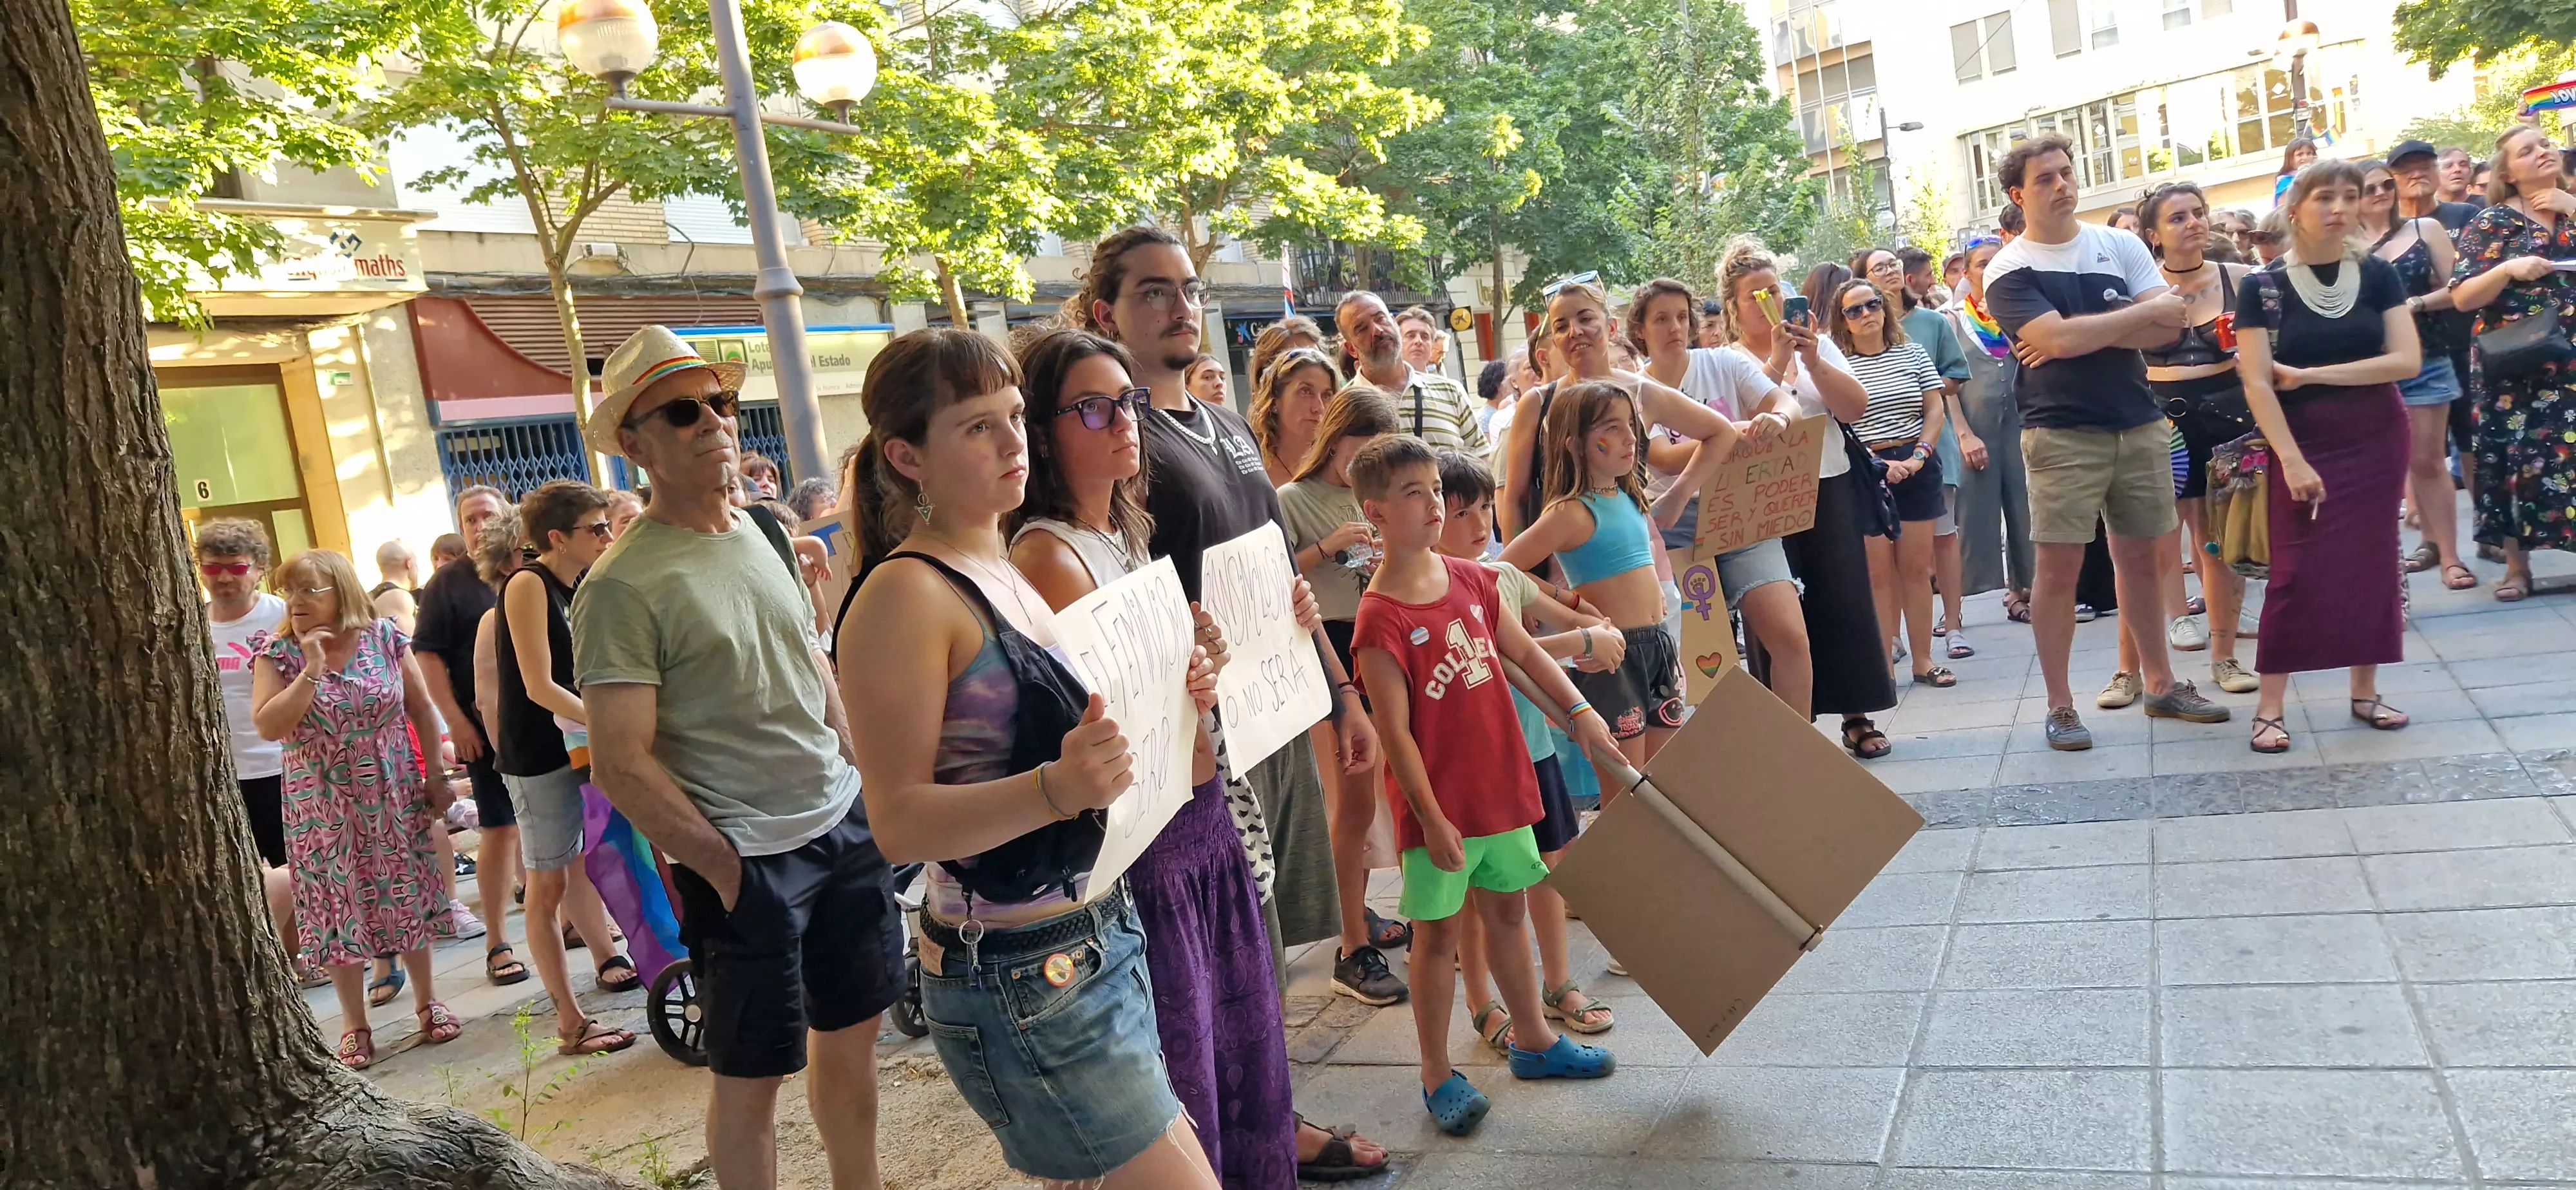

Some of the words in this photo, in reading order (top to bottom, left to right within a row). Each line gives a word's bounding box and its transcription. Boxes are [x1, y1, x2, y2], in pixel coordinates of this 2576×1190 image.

[354, 254, 407, 278] maths
[747, 341, 770, 354] Lote
[752, 358, 773, 373] Apu
[819, 354, 851, 367] Estado
[197, 481, 209, 499] 6
[1707, 493, 1734, 513] ES
[1754, 472, 1812, 504] PODER
[1705, 511, 1743, 533] SER
[1763, 490, 1818, 516] QUERER
[1718, 527, 1745, 550] SIN
[1756, 509, 1812, 539] MIEDO
[1445, 618, 1493, 690] 1
[1079, 645, 1114, 708] EL
[1226, 695, 1238, 728] O
[1242, 681, 1262, 719] NO
[1260, 636, 1309, 712] SERÁ
